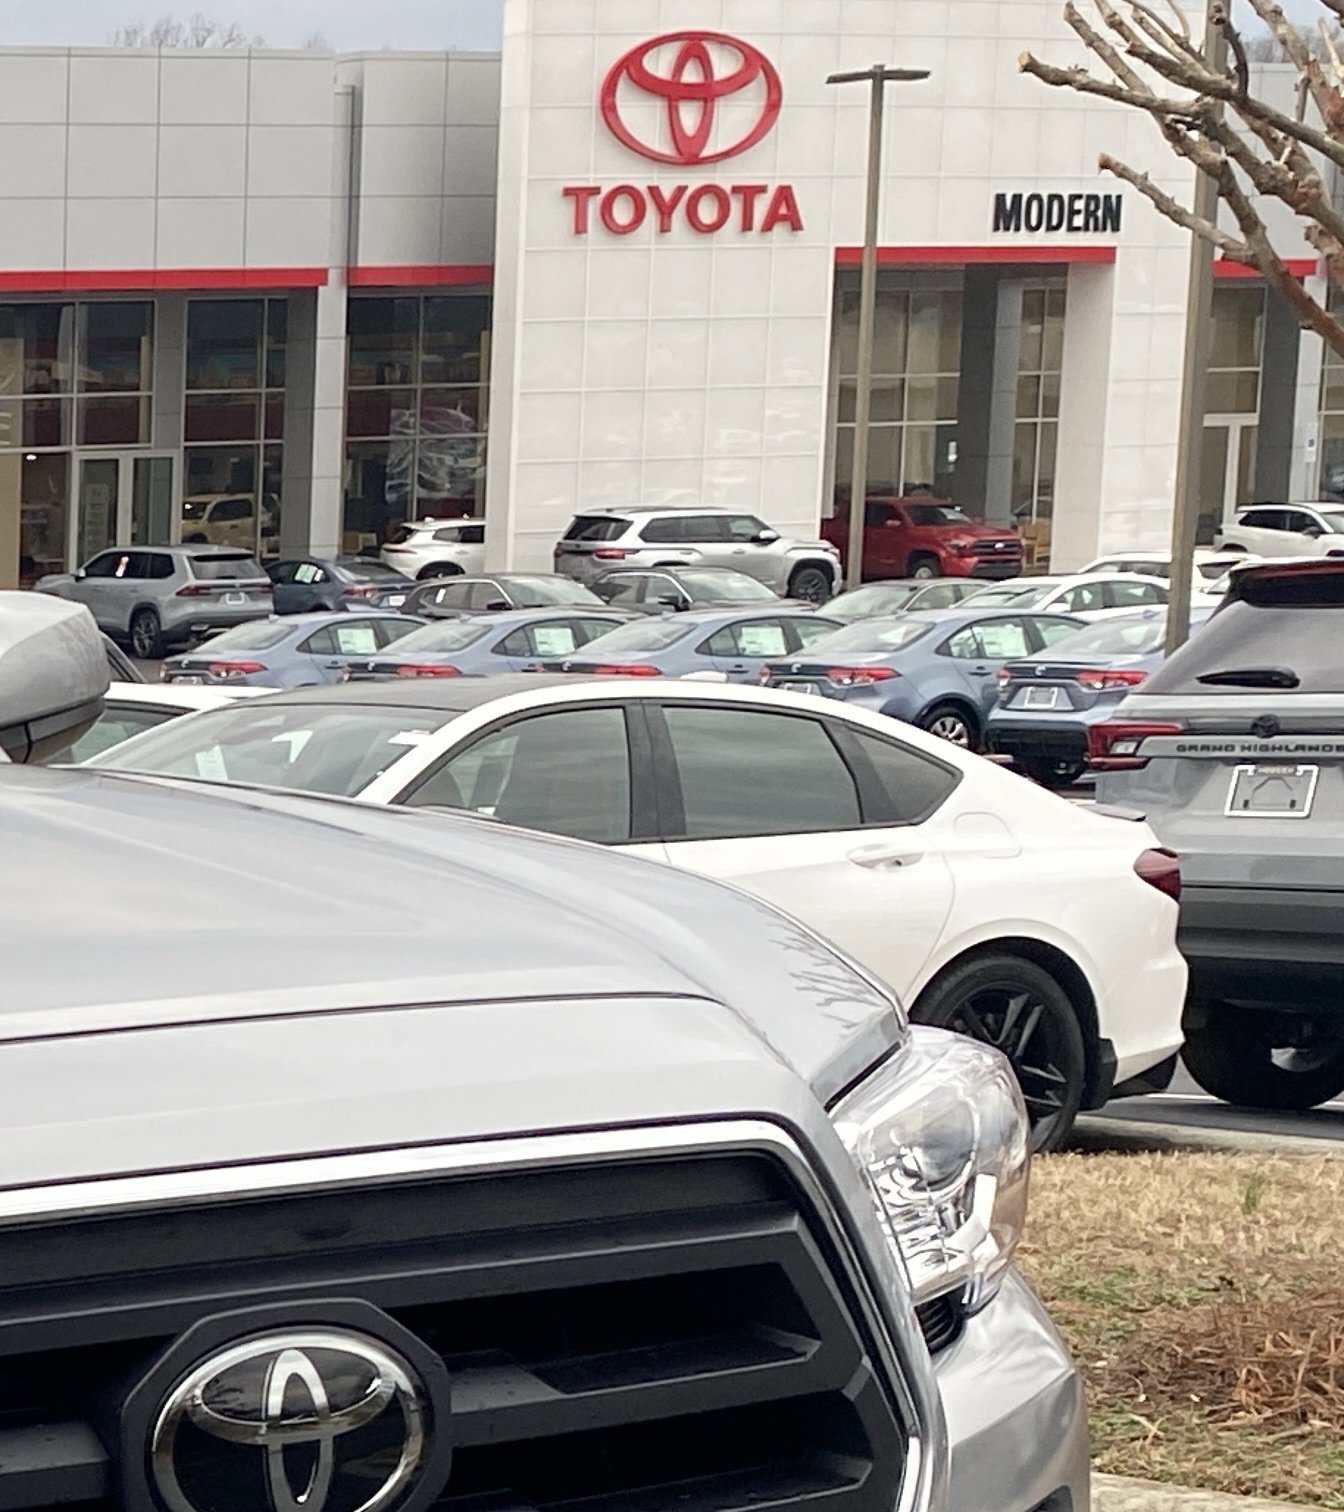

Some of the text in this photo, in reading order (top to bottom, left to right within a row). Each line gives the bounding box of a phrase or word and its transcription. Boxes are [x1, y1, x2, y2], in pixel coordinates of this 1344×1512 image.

[562, 184, 804, 235] TOYOTA
[992, 193, 1123, 233] MODERN
[1176, 743, 1236, 753] GRAND
